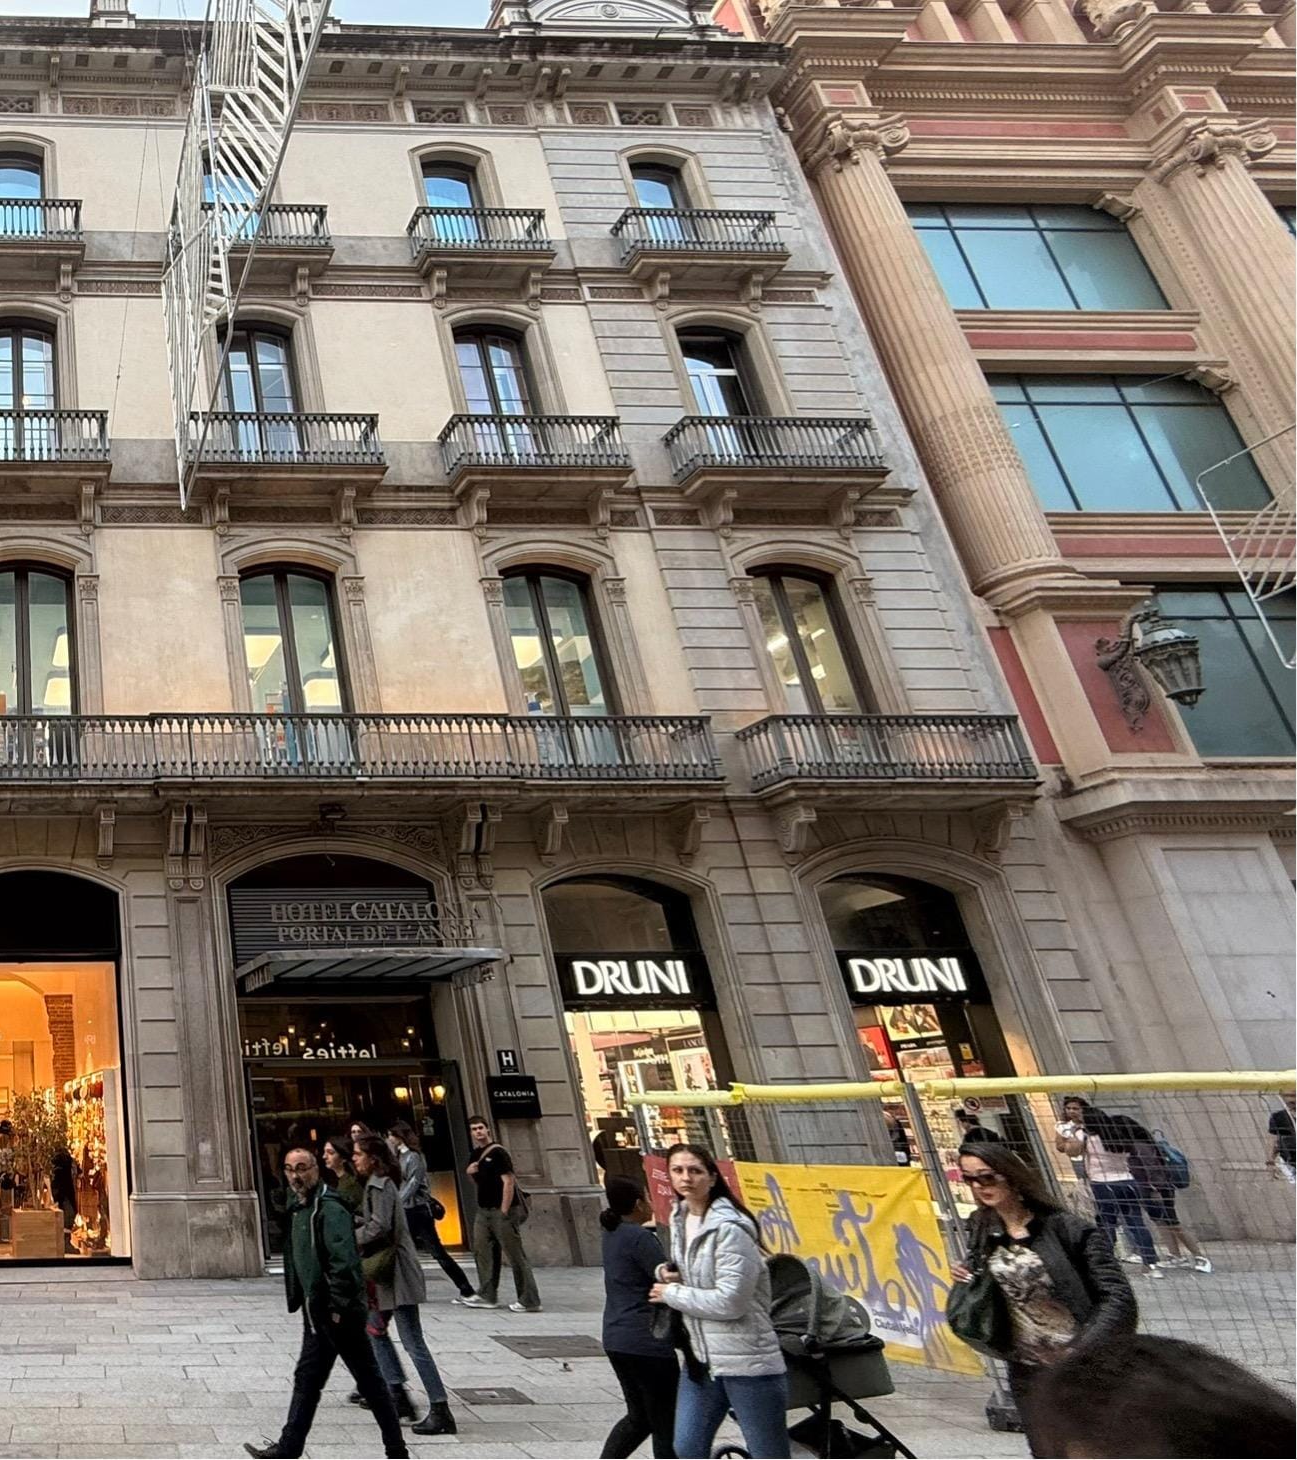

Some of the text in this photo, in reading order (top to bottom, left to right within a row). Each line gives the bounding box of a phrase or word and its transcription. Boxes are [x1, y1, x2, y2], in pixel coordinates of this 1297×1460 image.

[270, 901, 481, 922] HOTEL CATALONIA
[278, 926, 359, 942] PORTAL
[363, 926, 390, 941] DE
[572, 960, 691, 995] DRUNI
[848, 957, 967, 992] DRUNI
[501, 1051, 514, 1066] H
